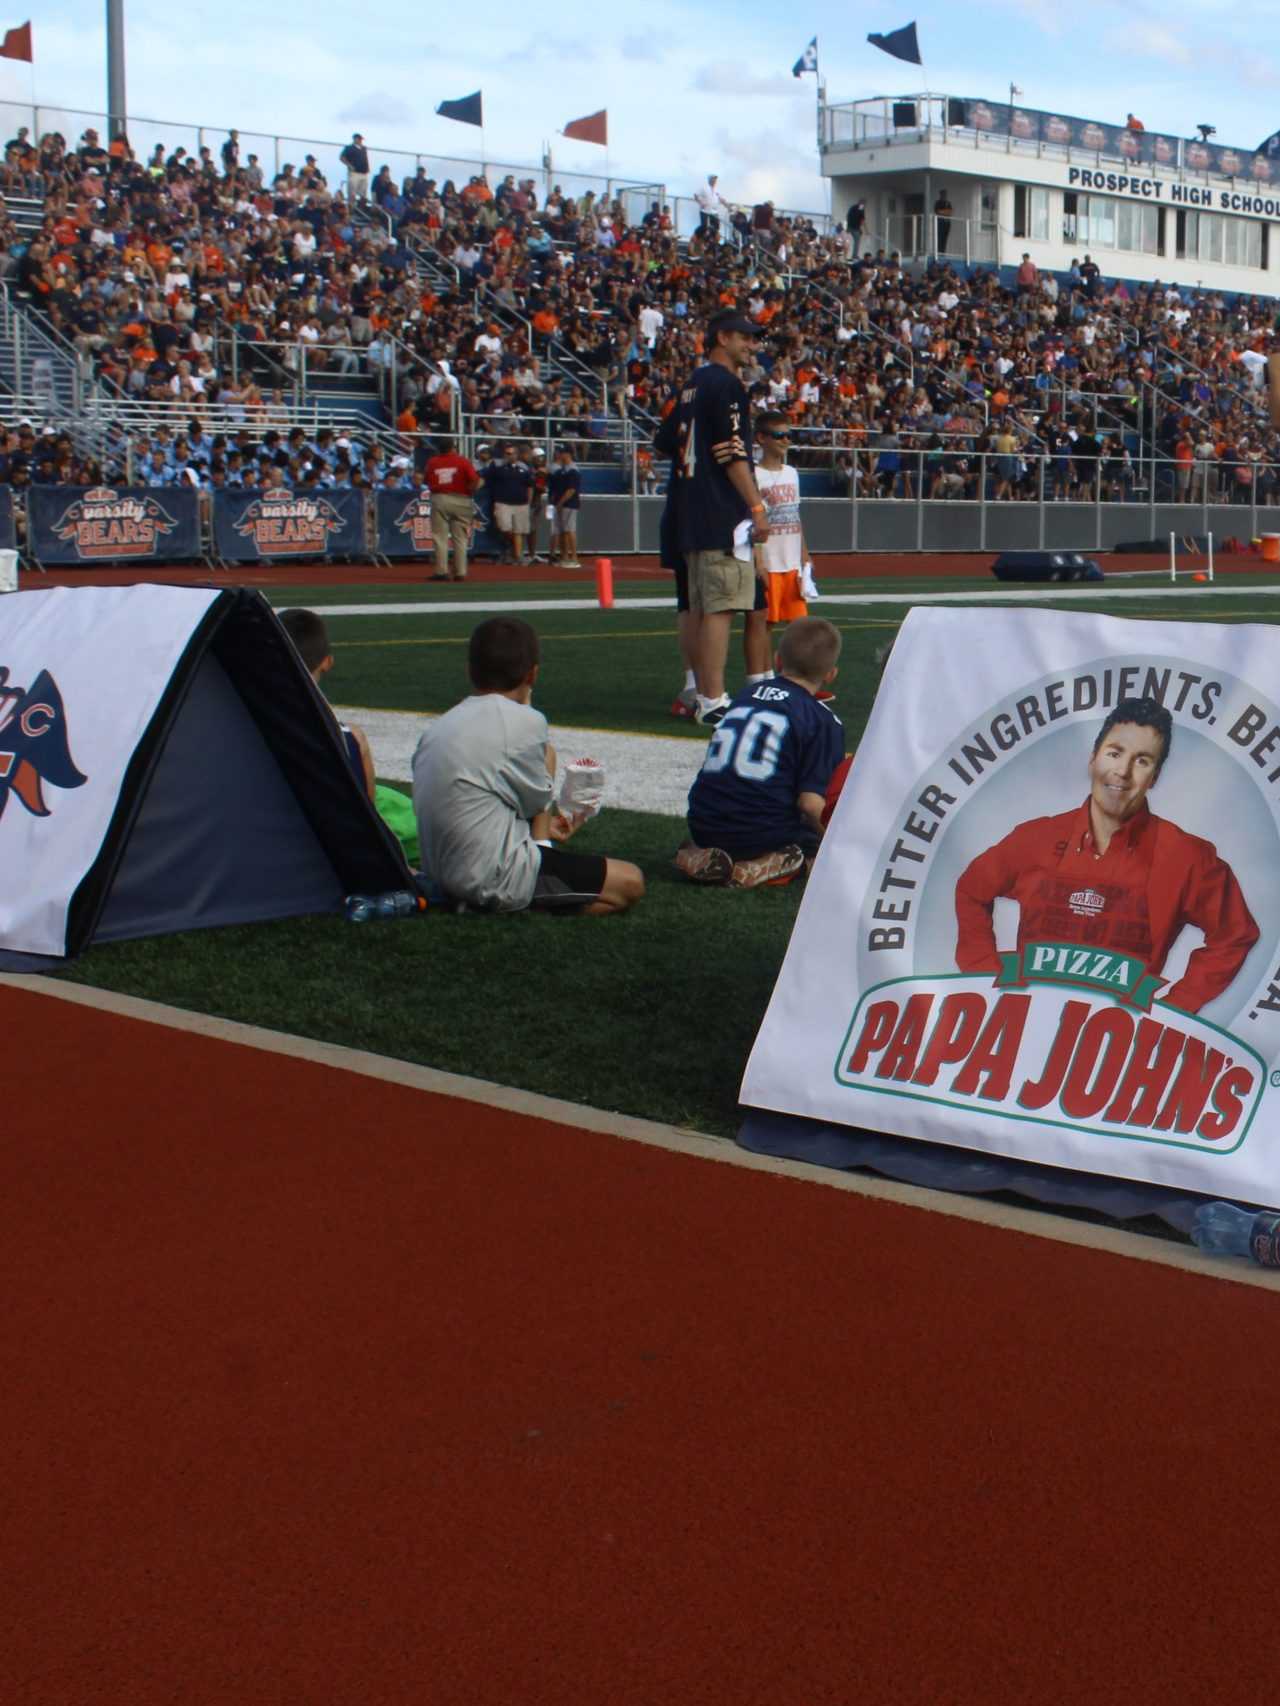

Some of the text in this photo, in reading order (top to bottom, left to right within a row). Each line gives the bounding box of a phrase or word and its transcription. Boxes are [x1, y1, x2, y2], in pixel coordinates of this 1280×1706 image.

[1069, 167, 1163, 199] PROSPECT
[1171, 184, 1213, 206] HIGH
[83, 501, 145, 523] varsity
[256, 518, 326, 542] BEARS
[77, 519, 154, 545] BEARS
[868, 784, 957, 952] BETTER
[948, 666, 1222, 785] INGREDIENTS.
[1030, 946, 1131, 987] PIZZA
[847, 992, 1255, 1142] PAPA JOHN'S
